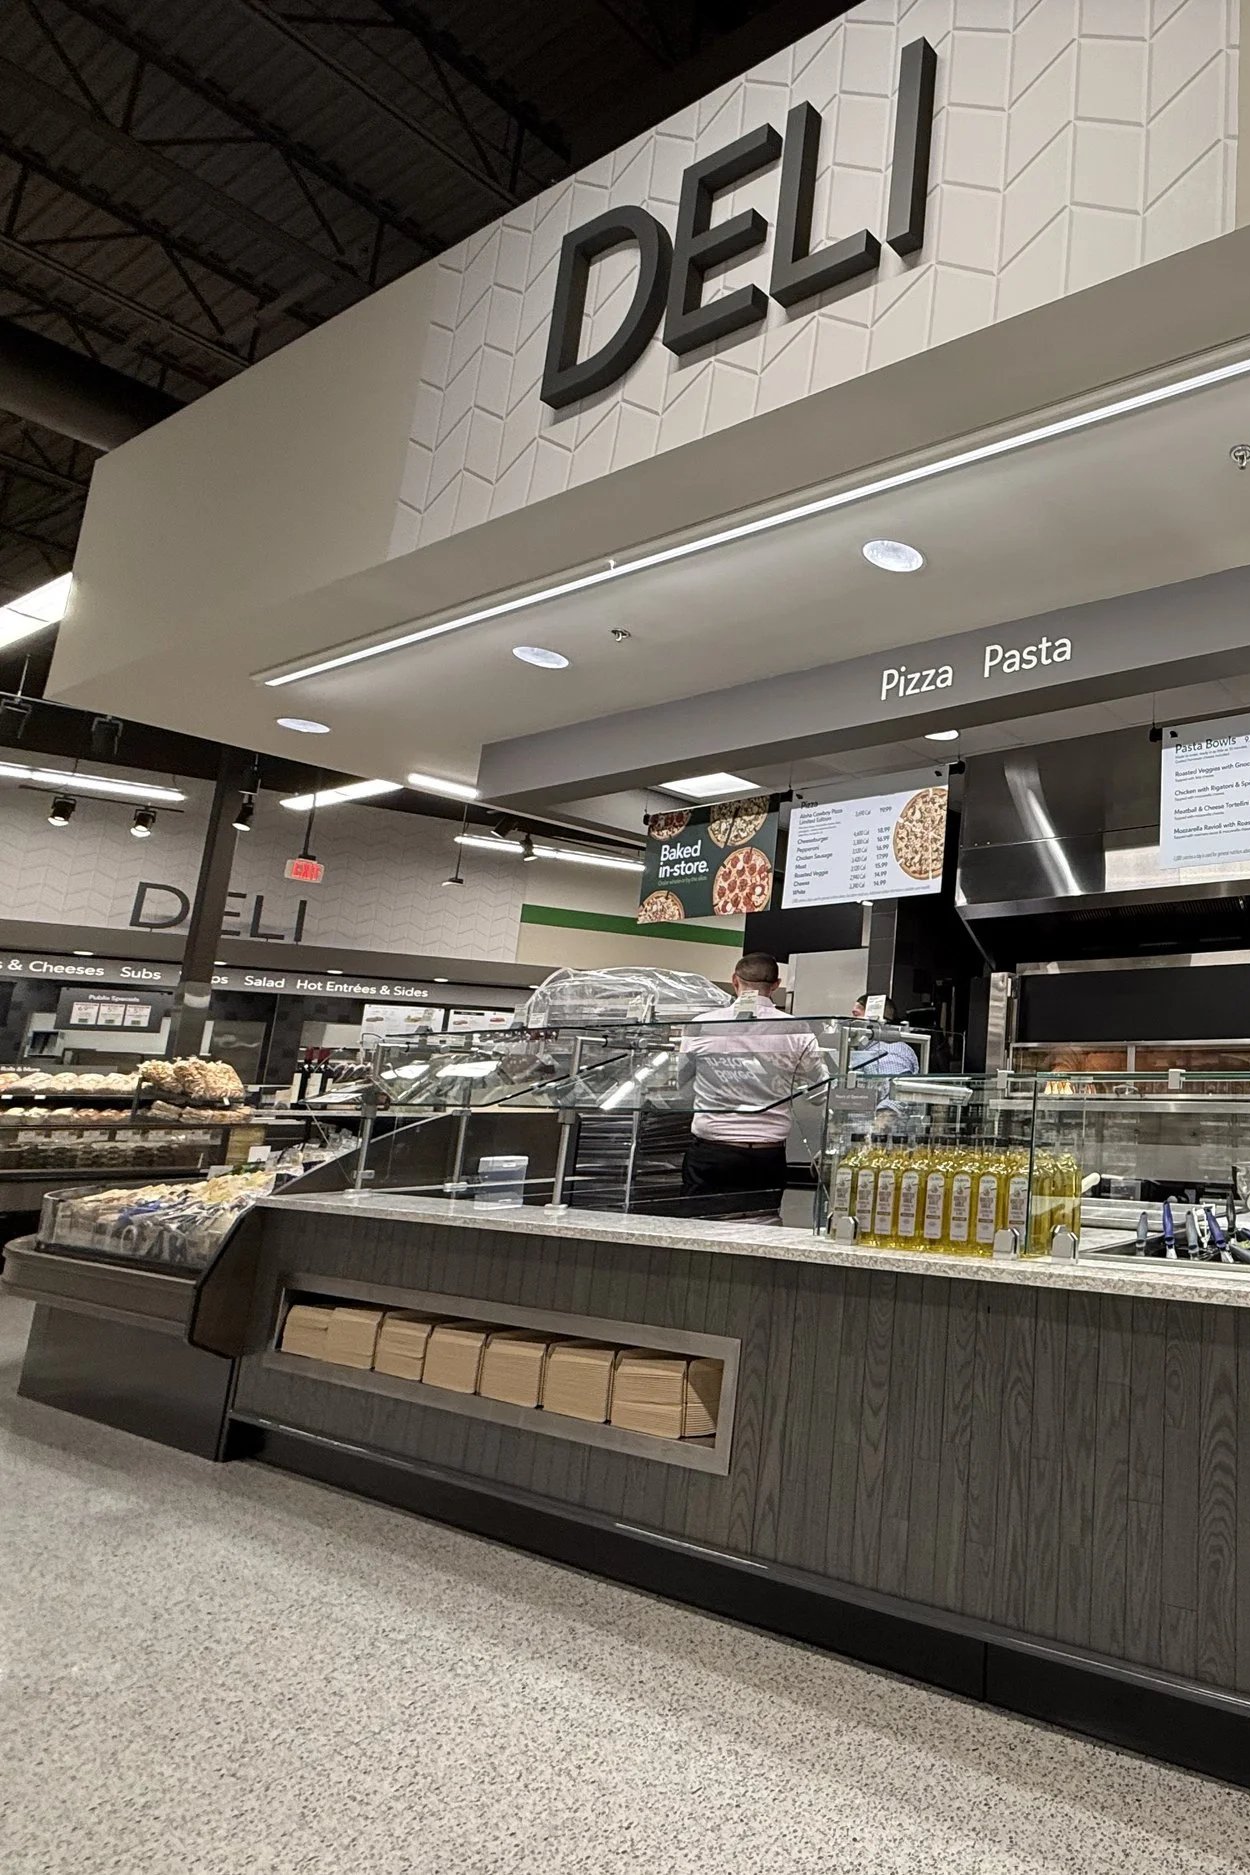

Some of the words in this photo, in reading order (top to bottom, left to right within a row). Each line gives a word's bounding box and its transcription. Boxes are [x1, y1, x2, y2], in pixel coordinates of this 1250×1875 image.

[540, 36, 937, 410] DELI
[984, 637, 1072, 678] Pasta
[880, 665, 954, 701] Pizza
[1176, 742, 1203, 754] Pasta
[1206, 736, 1237, 749] Bowls
[1175, 769, 1197, 777] Roasted
[1198, 766, 1220, 775] Veggies
[1175, 788, 1196, 796] Chicken
[1211, 784, 1234, 792] Rigatoni
[801, 801, 819, 809] Pizza
[1174, 807, 1197, 815] Meatball
[1174, 826, 1203, 834] Mozzarella
[661, 840, 702, 861] Baked
[291, 860, 321, 881] EXIT
[658, 860, 709, 879] in-store.
[8, 960, 23, 971] &
[29, 961, 105, 976] Cheeses
[120, 966, 162, 980] Subs
[244, 976, 286, 988] Salad
[296, 979, 323, 991] Hot
[326, 981, 376, 995] Entrées
[380, 985, 391, 996] &
[393, 986, 429, 998] Sides
